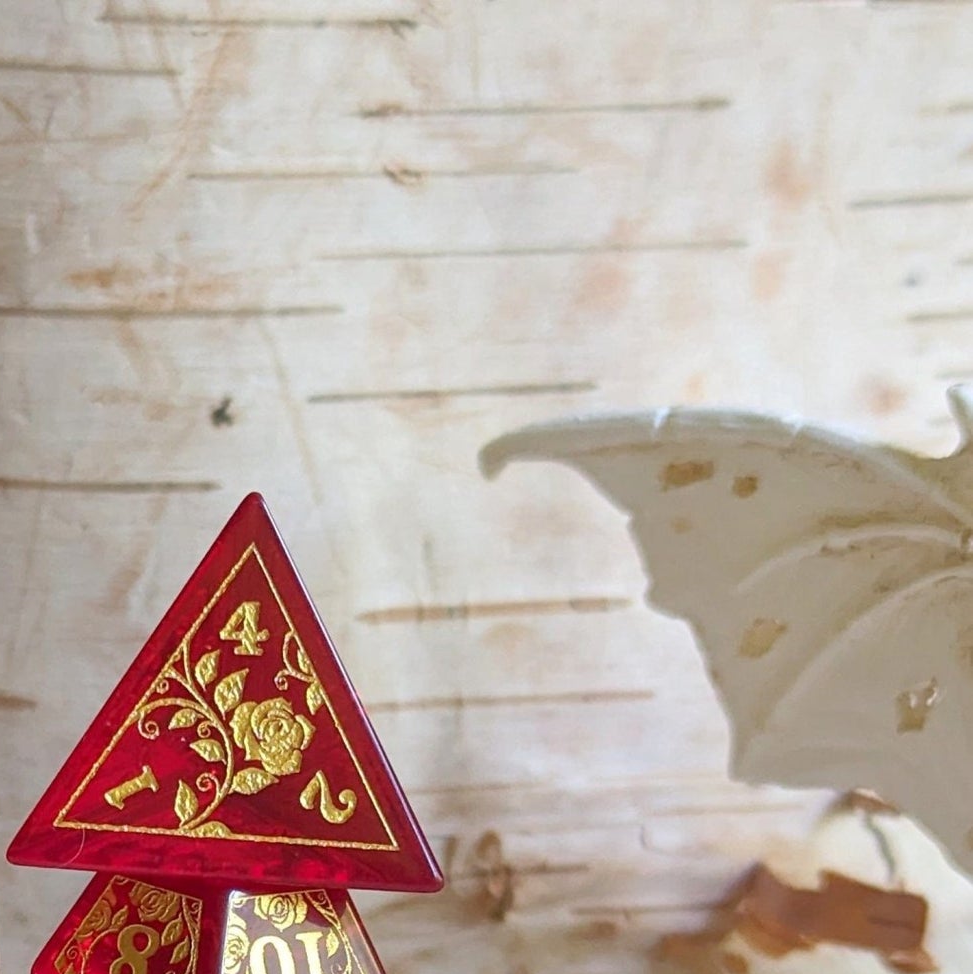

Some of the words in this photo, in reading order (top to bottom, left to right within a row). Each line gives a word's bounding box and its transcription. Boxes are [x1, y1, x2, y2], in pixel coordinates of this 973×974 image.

[219, 601, 270, 656] 4
[105, 766, 160, 810] 1
[300, 770, 357, 824] 2
